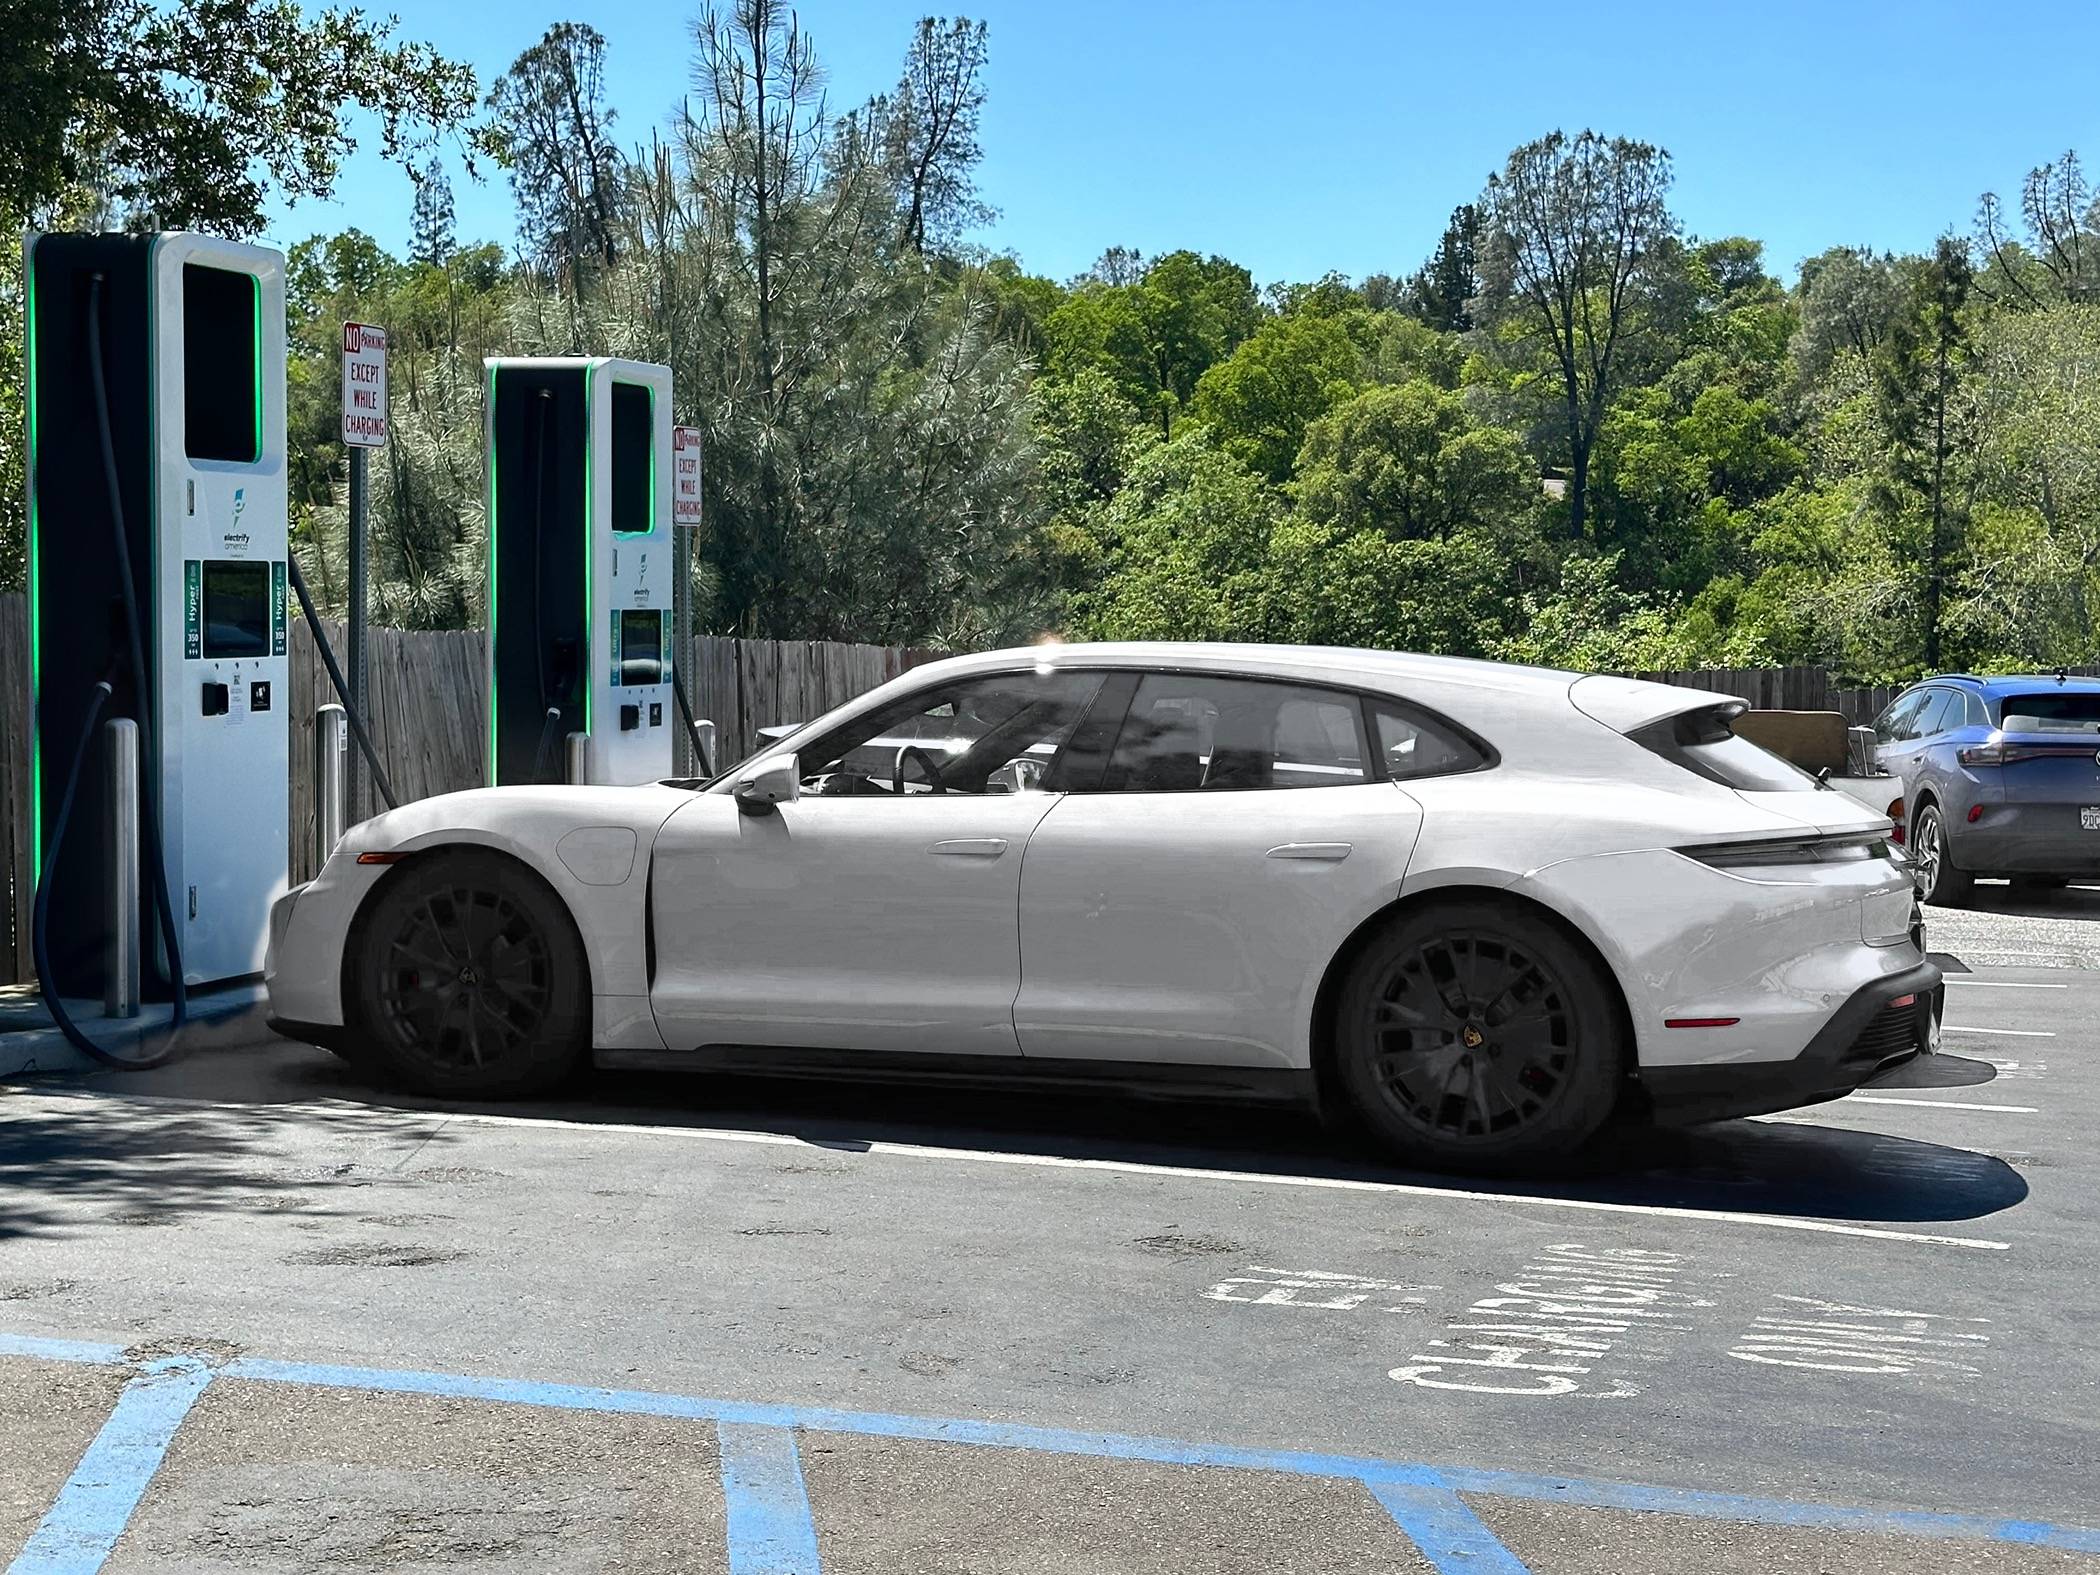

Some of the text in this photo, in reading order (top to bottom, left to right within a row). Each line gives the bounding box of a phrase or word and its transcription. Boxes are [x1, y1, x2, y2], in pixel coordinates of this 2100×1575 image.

[345, 326, 385, 351] NO PARKING
[351, 362, 379, 384] EXCEPT
[353, 388, 377, 410] WHILE
[345, 414, 385, 437] CHARGING
[675, 429, 684, 450] NO
[224, 533, 250, 544] electrify
[189, 585, 197, 622] Hyper
[276, 584, 284, 620] Hyper
[187, 633, 199, 642] 350
[275, 631, 285, 640] 350
[1388, 1243, 1690, 1396] CHARGING
